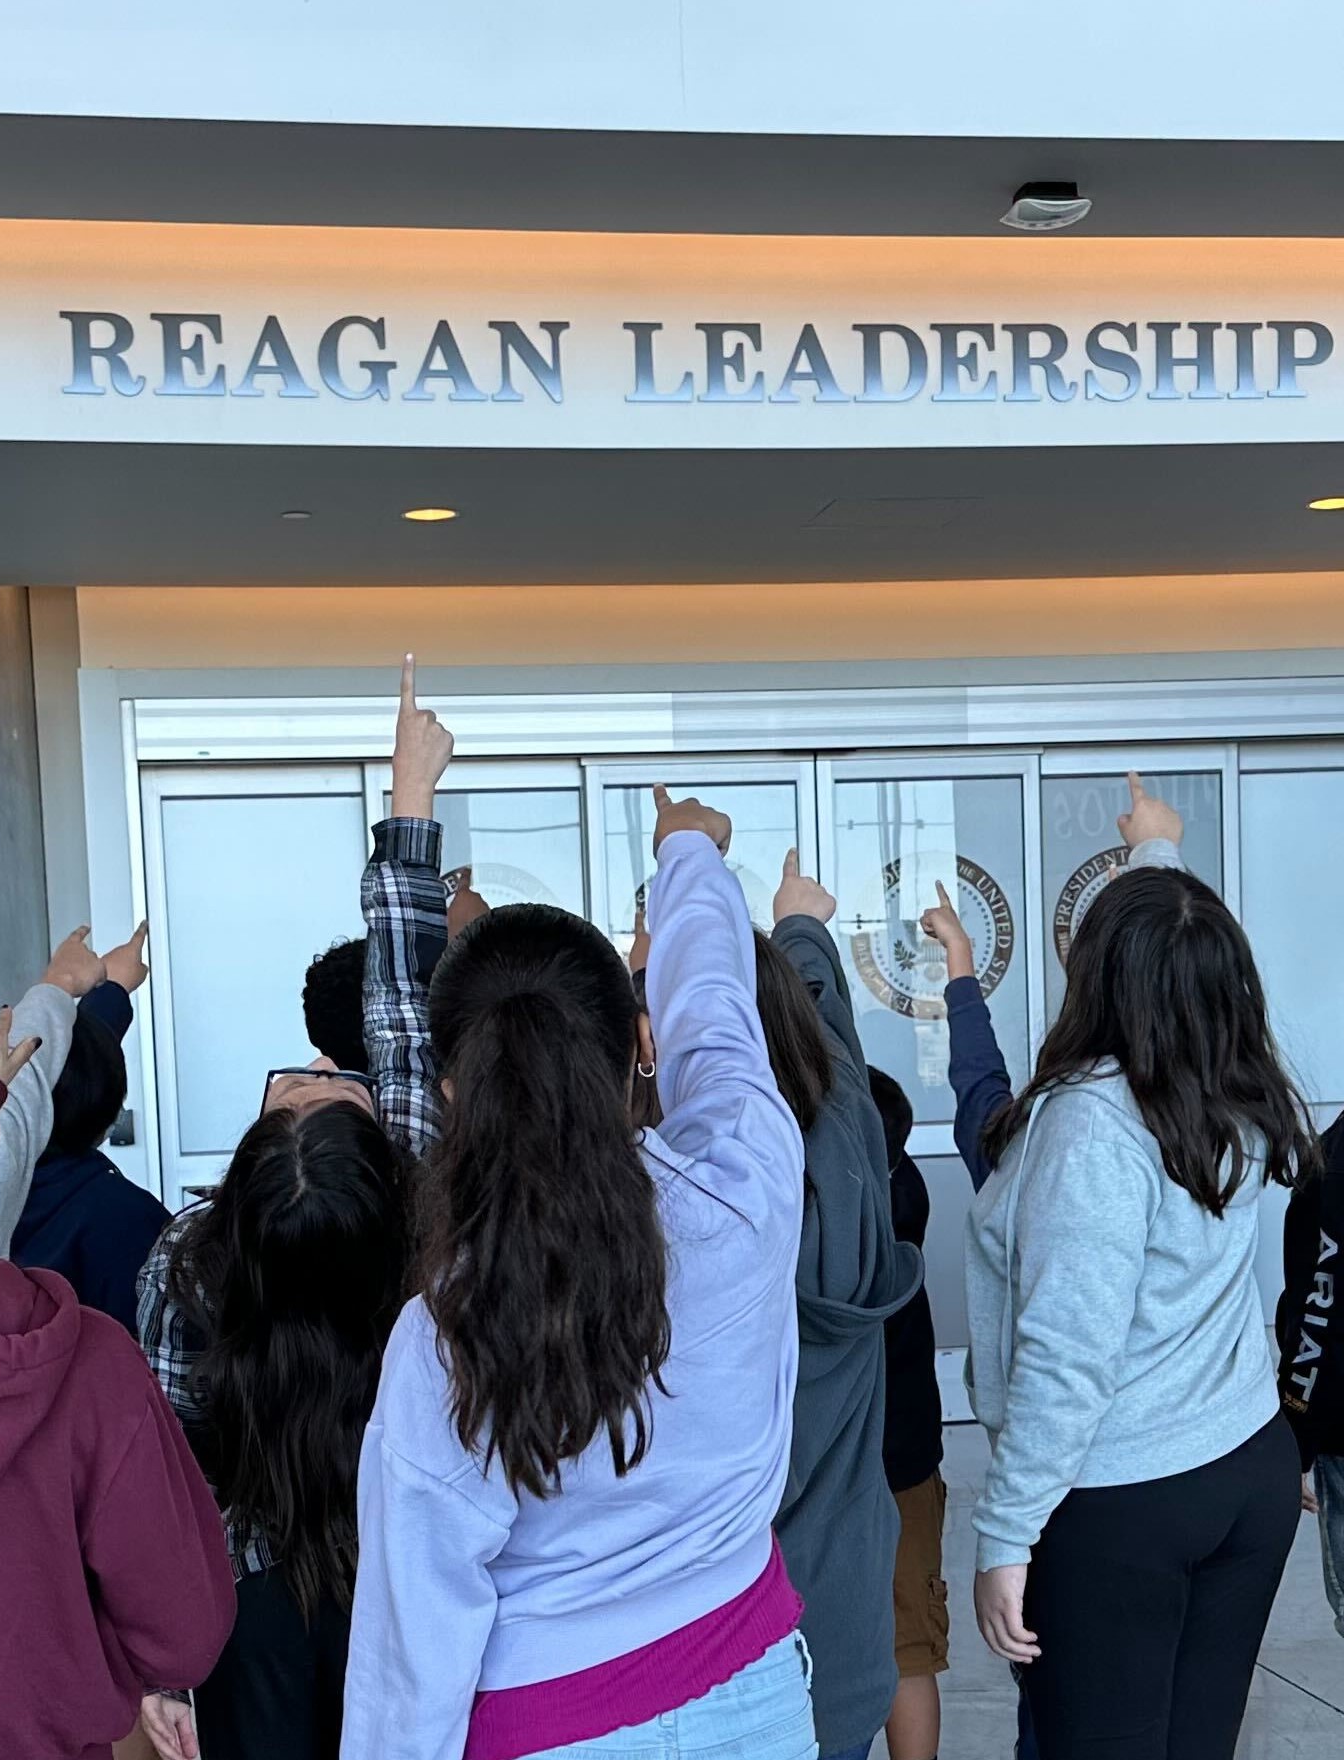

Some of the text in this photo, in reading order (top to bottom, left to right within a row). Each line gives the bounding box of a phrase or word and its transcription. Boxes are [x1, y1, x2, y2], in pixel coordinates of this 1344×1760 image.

[59, 310, 570, 404] REAGAN
[622, 321, 1335, 404] LEADERSHIP
[976, 875, 1012, 949] UNITED
[1055, 849, 1129, 927] PRESIDENT
[979, 957, 1006, 997] STA
[1291, 1227, 1338, 1402] ARIAT
